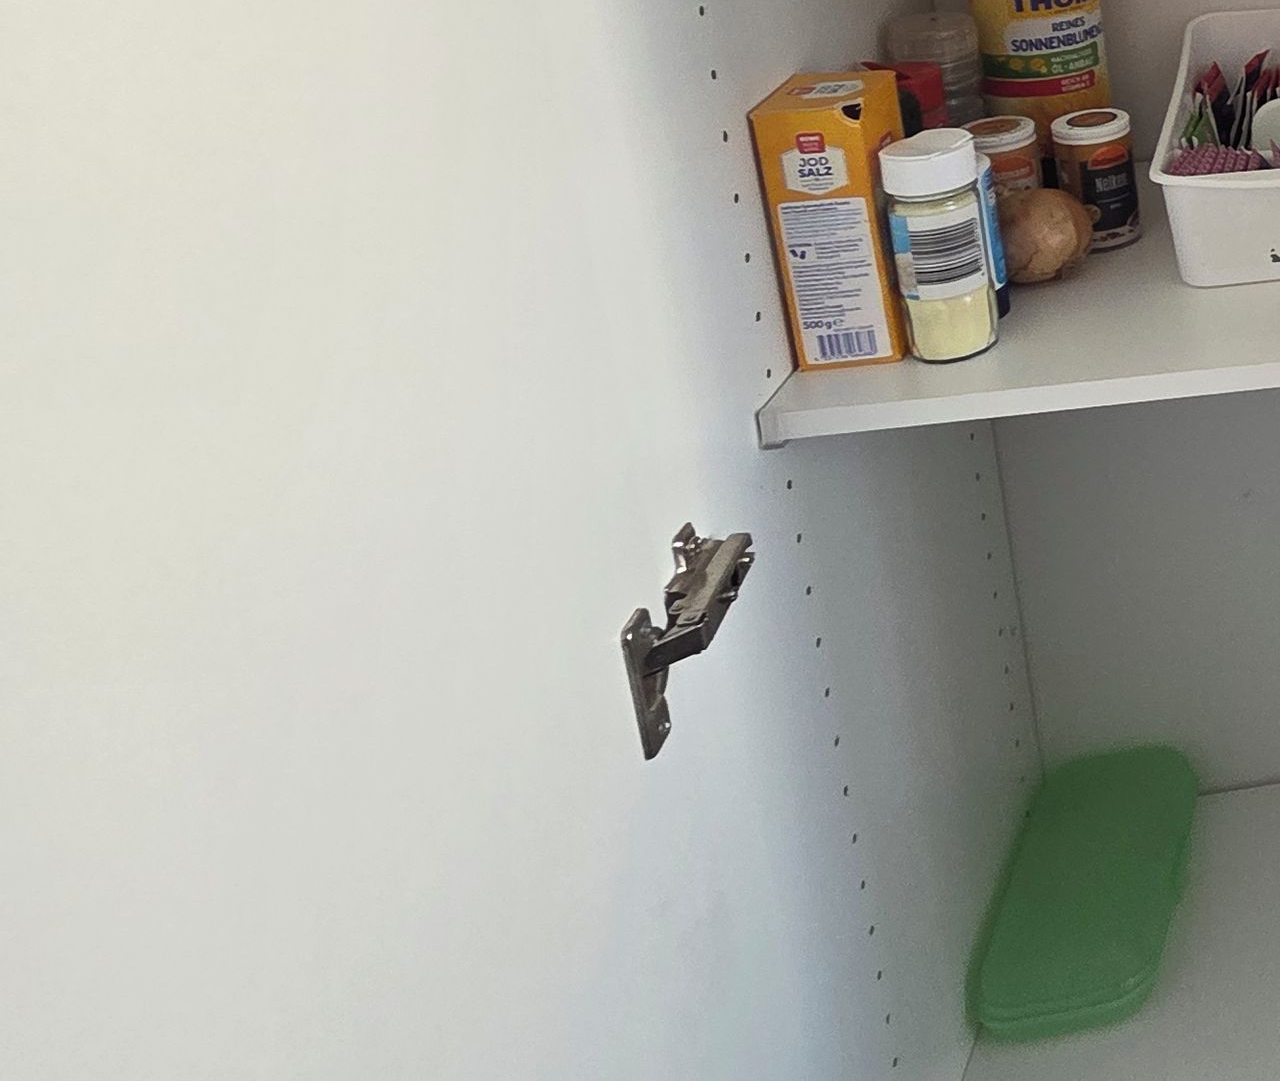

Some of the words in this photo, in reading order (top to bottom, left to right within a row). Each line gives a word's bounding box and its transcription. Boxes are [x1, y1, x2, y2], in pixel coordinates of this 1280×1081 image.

[1051, 15, 1085, 33] REINES
[798, 156, 829, 168] JOD
[797, 166, 834, 178] SALZ
